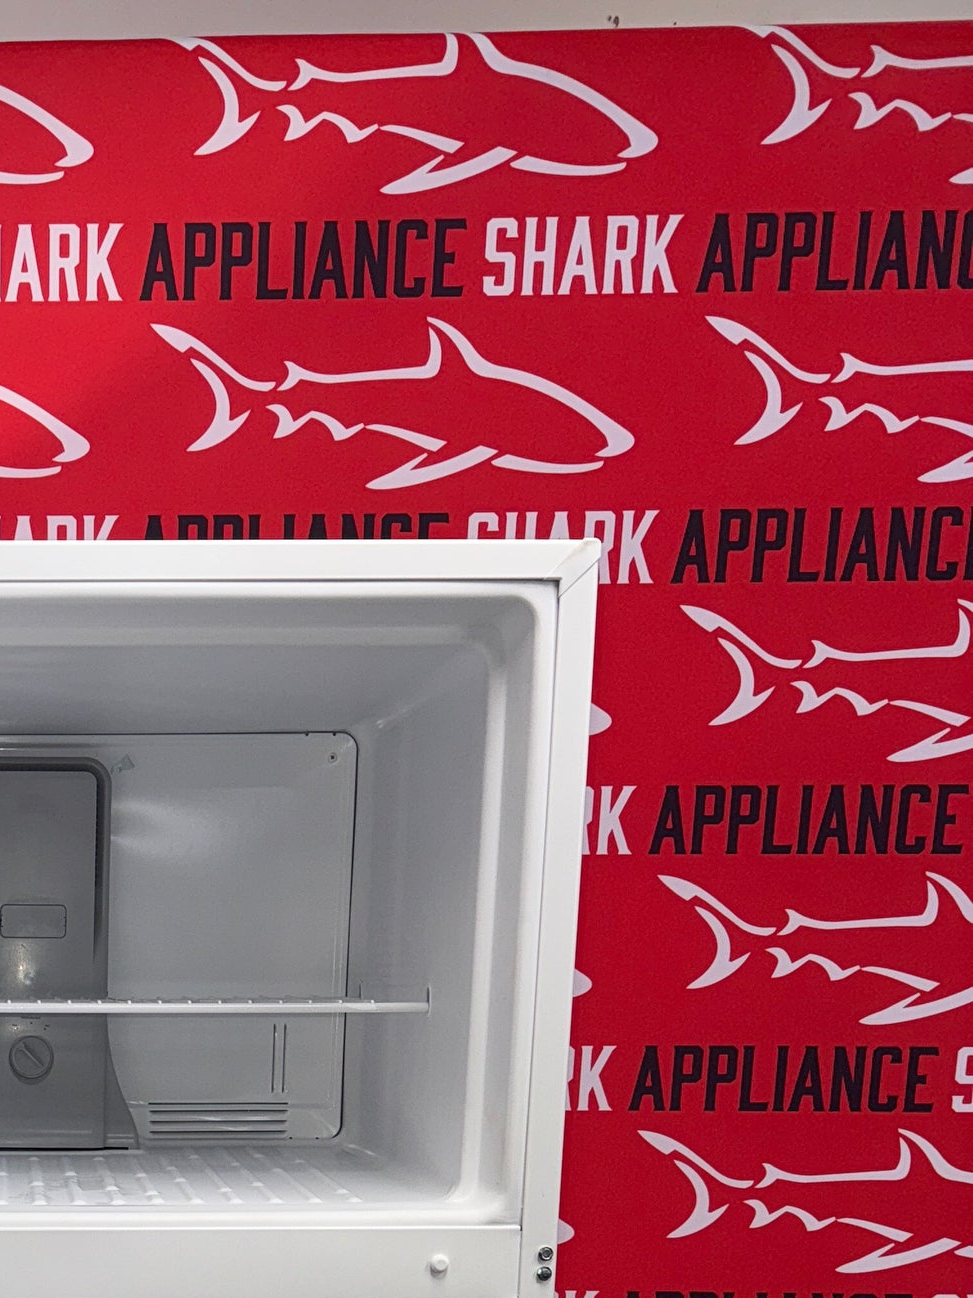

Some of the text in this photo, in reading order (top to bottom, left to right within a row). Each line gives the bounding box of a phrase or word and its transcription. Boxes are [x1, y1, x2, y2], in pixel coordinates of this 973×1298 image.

[140, 219, 468, 301] APPLIANCE
[483, 215, 685, 297] SHARK
[648, 784, 970, 855] APPLIANCE
[628, 1045, 940, 1113] APPLIANCE
